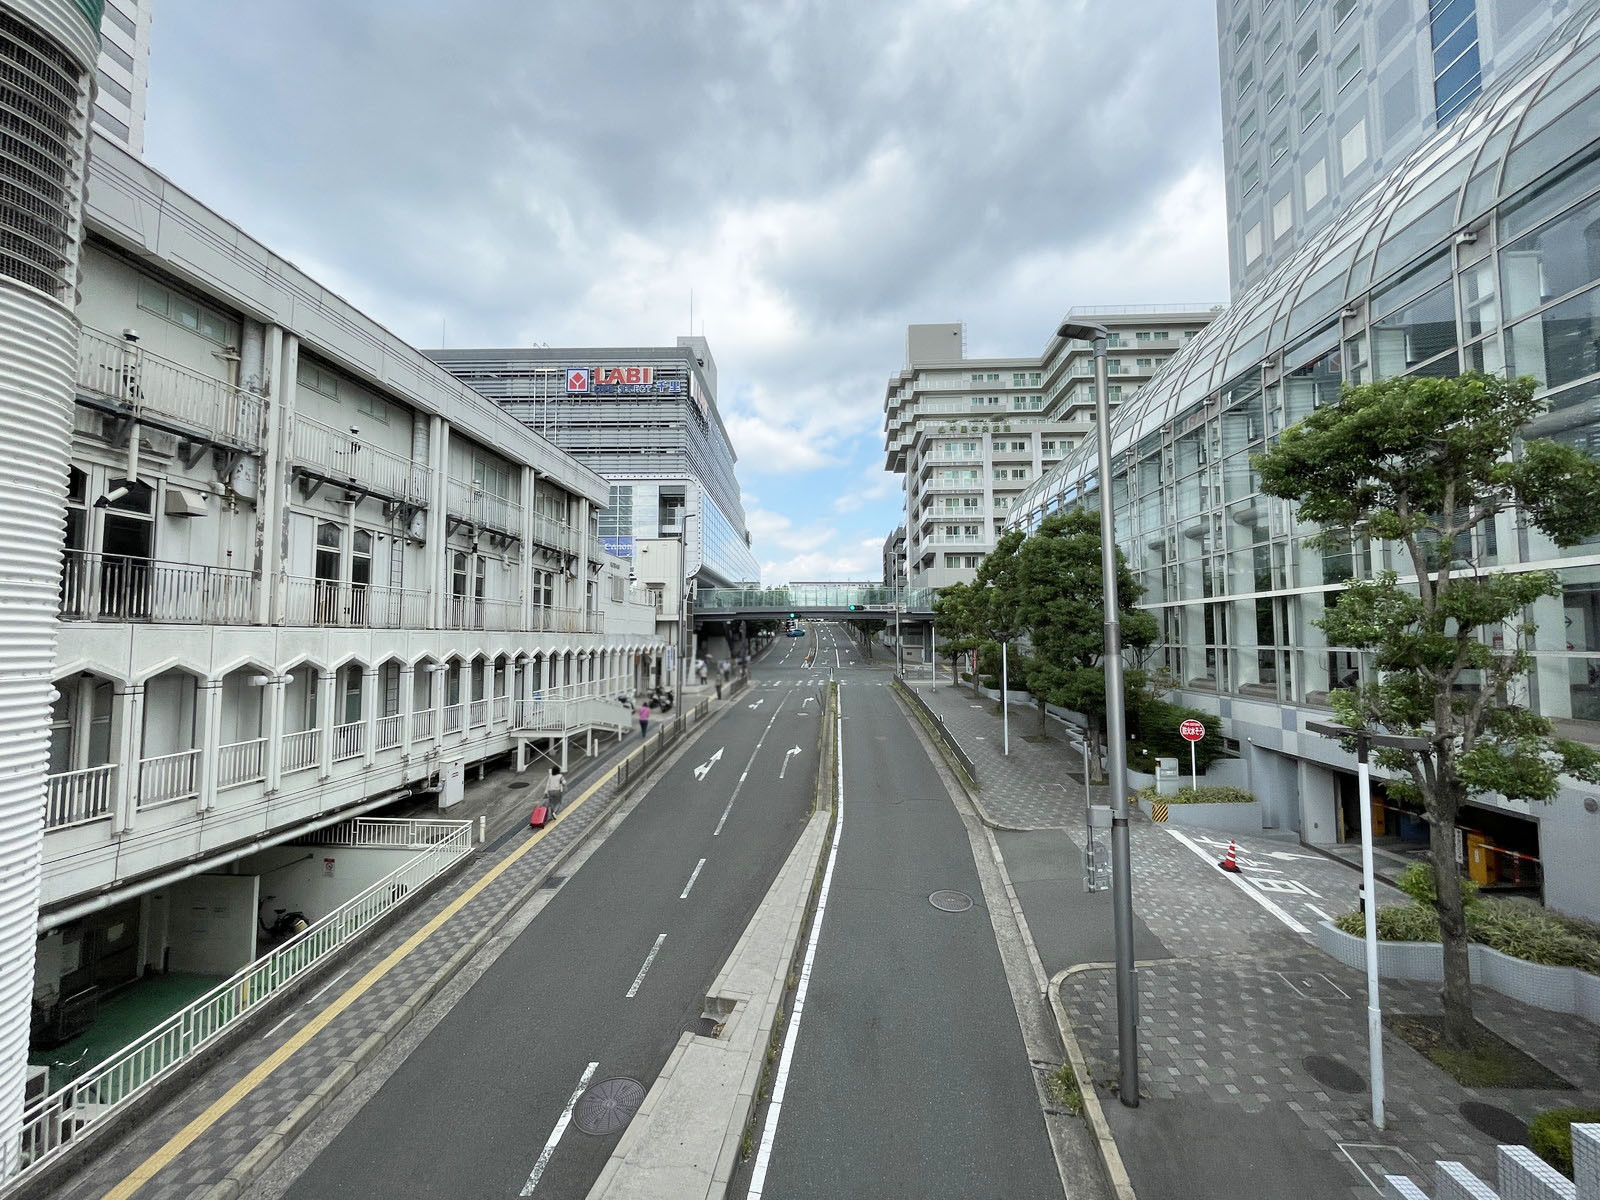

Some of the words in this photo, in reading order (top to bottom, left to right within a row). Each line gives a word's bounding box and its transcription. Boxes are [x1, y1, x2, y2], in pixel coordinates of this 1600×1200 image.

[594, 367, 653, 384] LABI
[618, 384, 653, 394] SELECT
[656, 381, 681, 394] 千里
